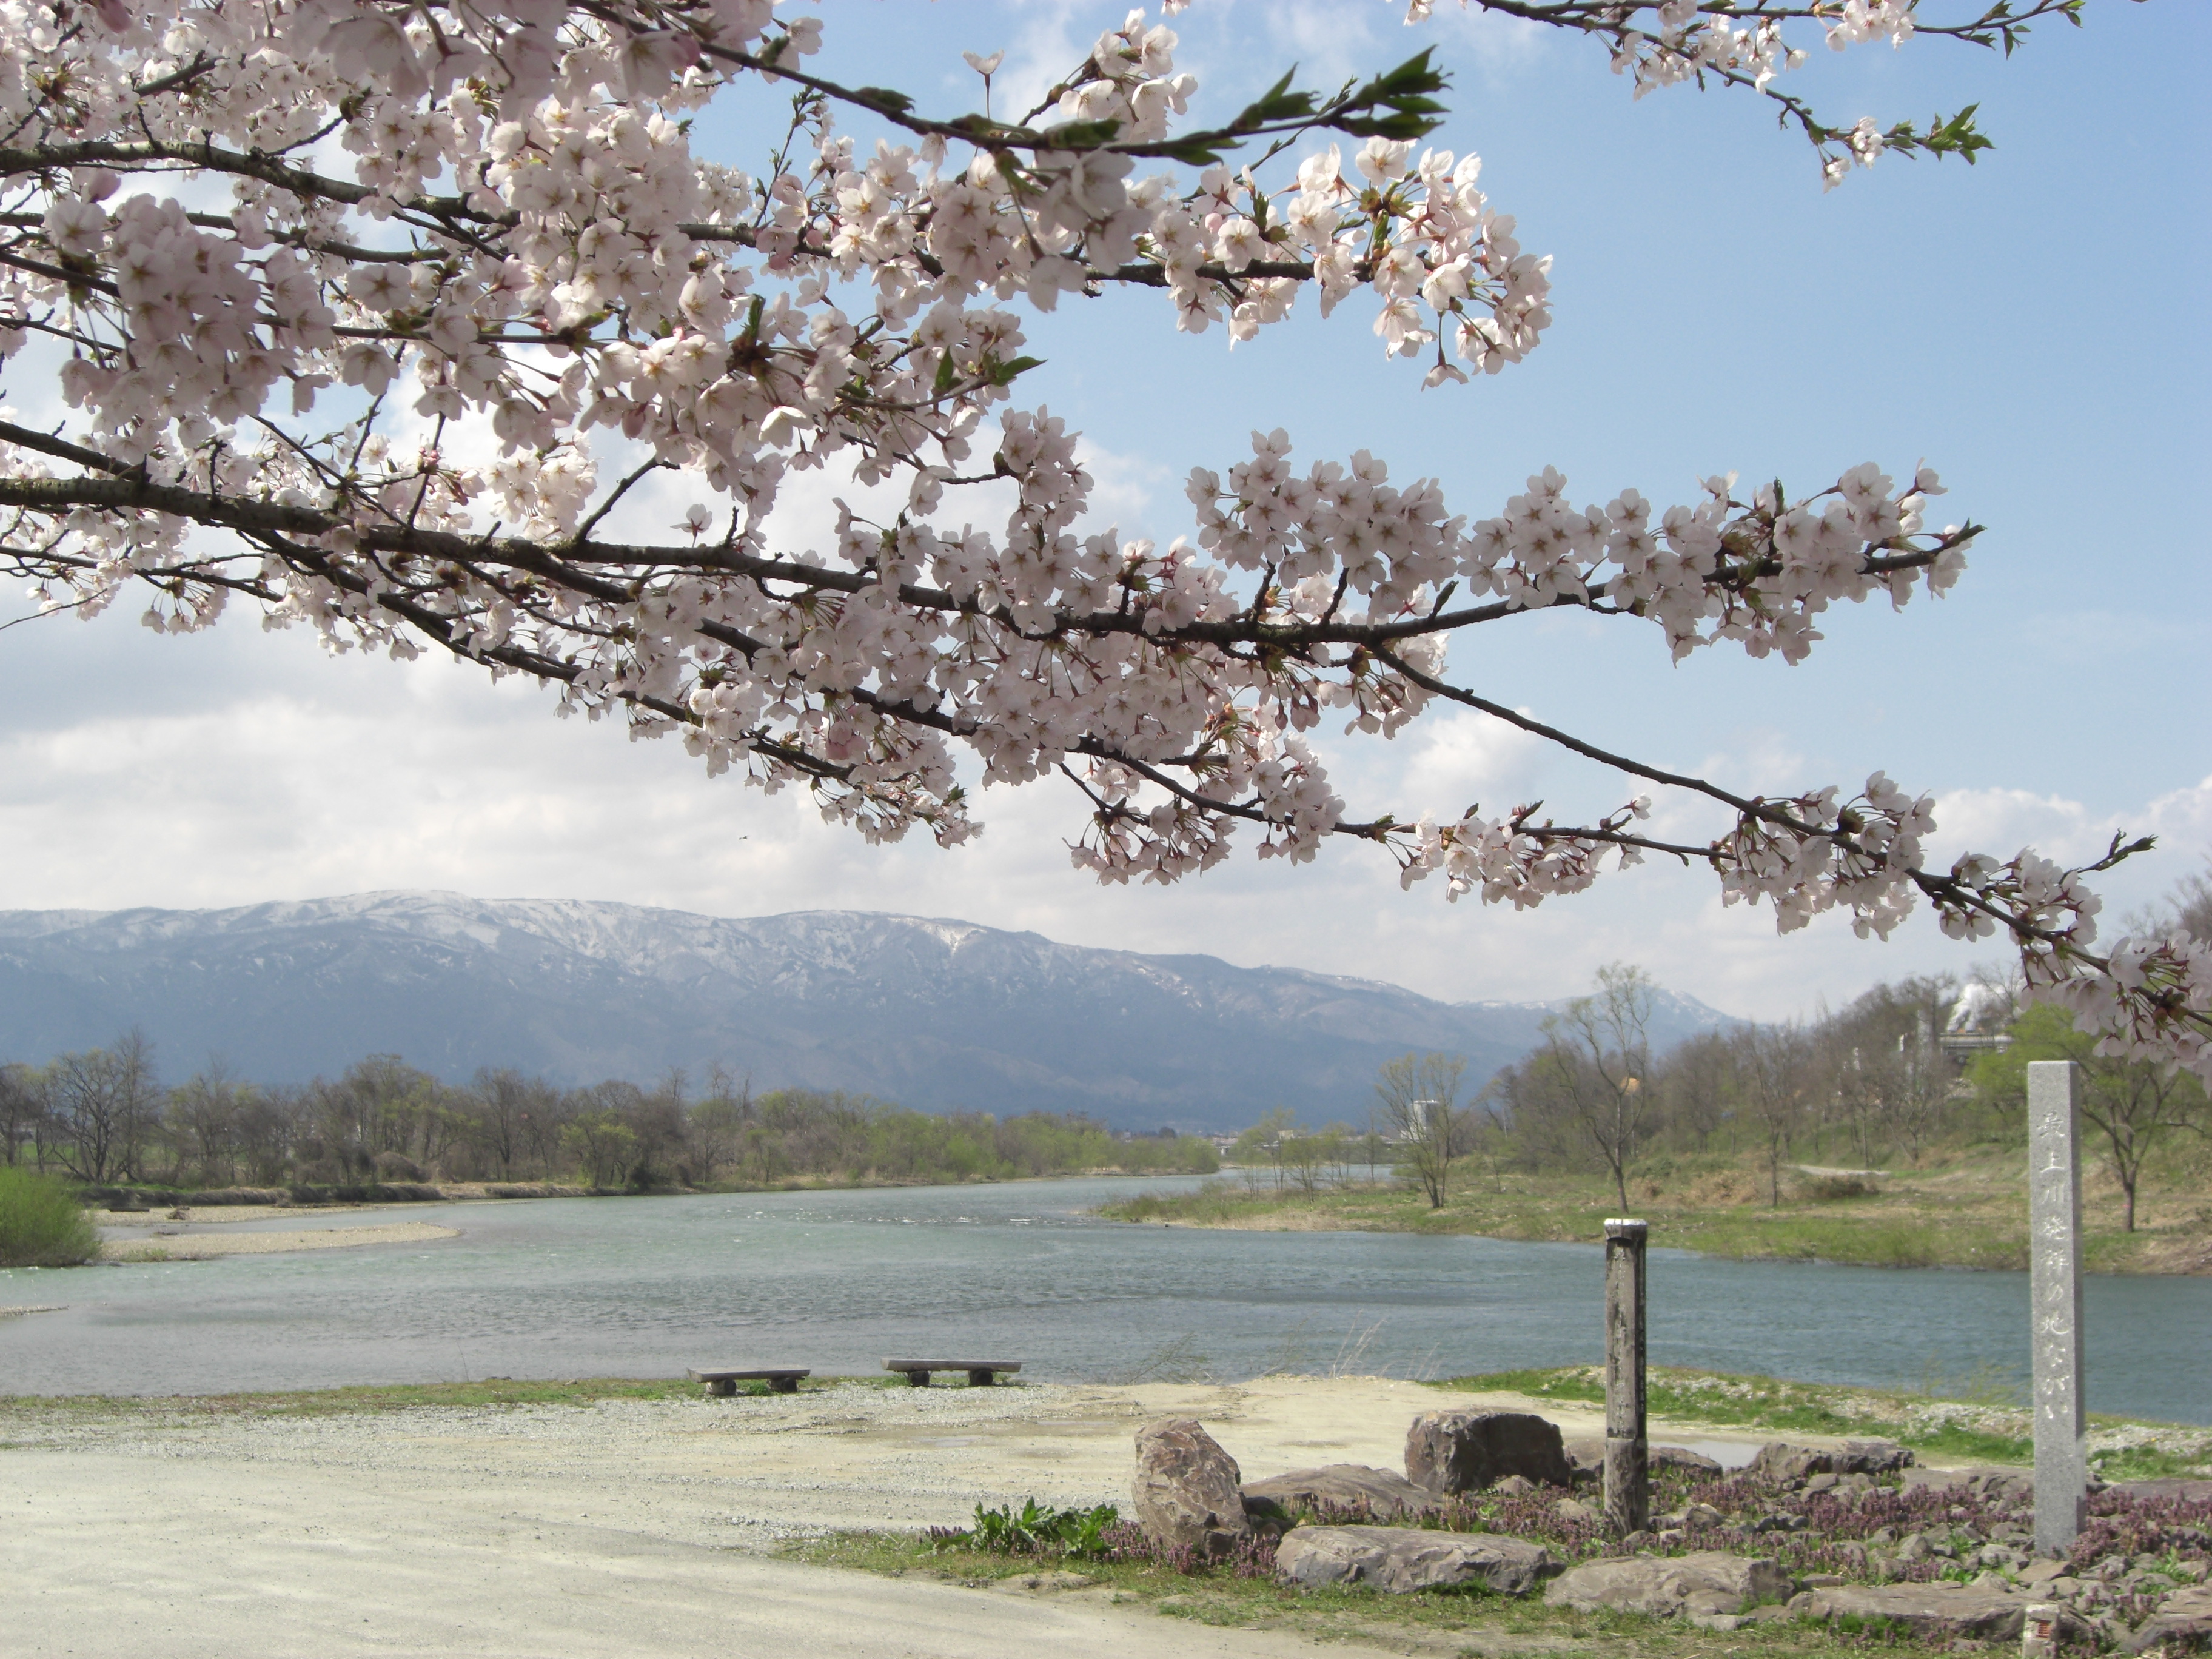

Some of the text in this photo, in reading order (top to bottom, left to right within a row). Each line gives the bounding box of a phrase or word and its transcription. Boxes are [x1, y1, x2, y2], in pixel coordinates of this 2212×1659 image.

[2037, 1110, 2070, 1419] 最上川発祥の地ながい
